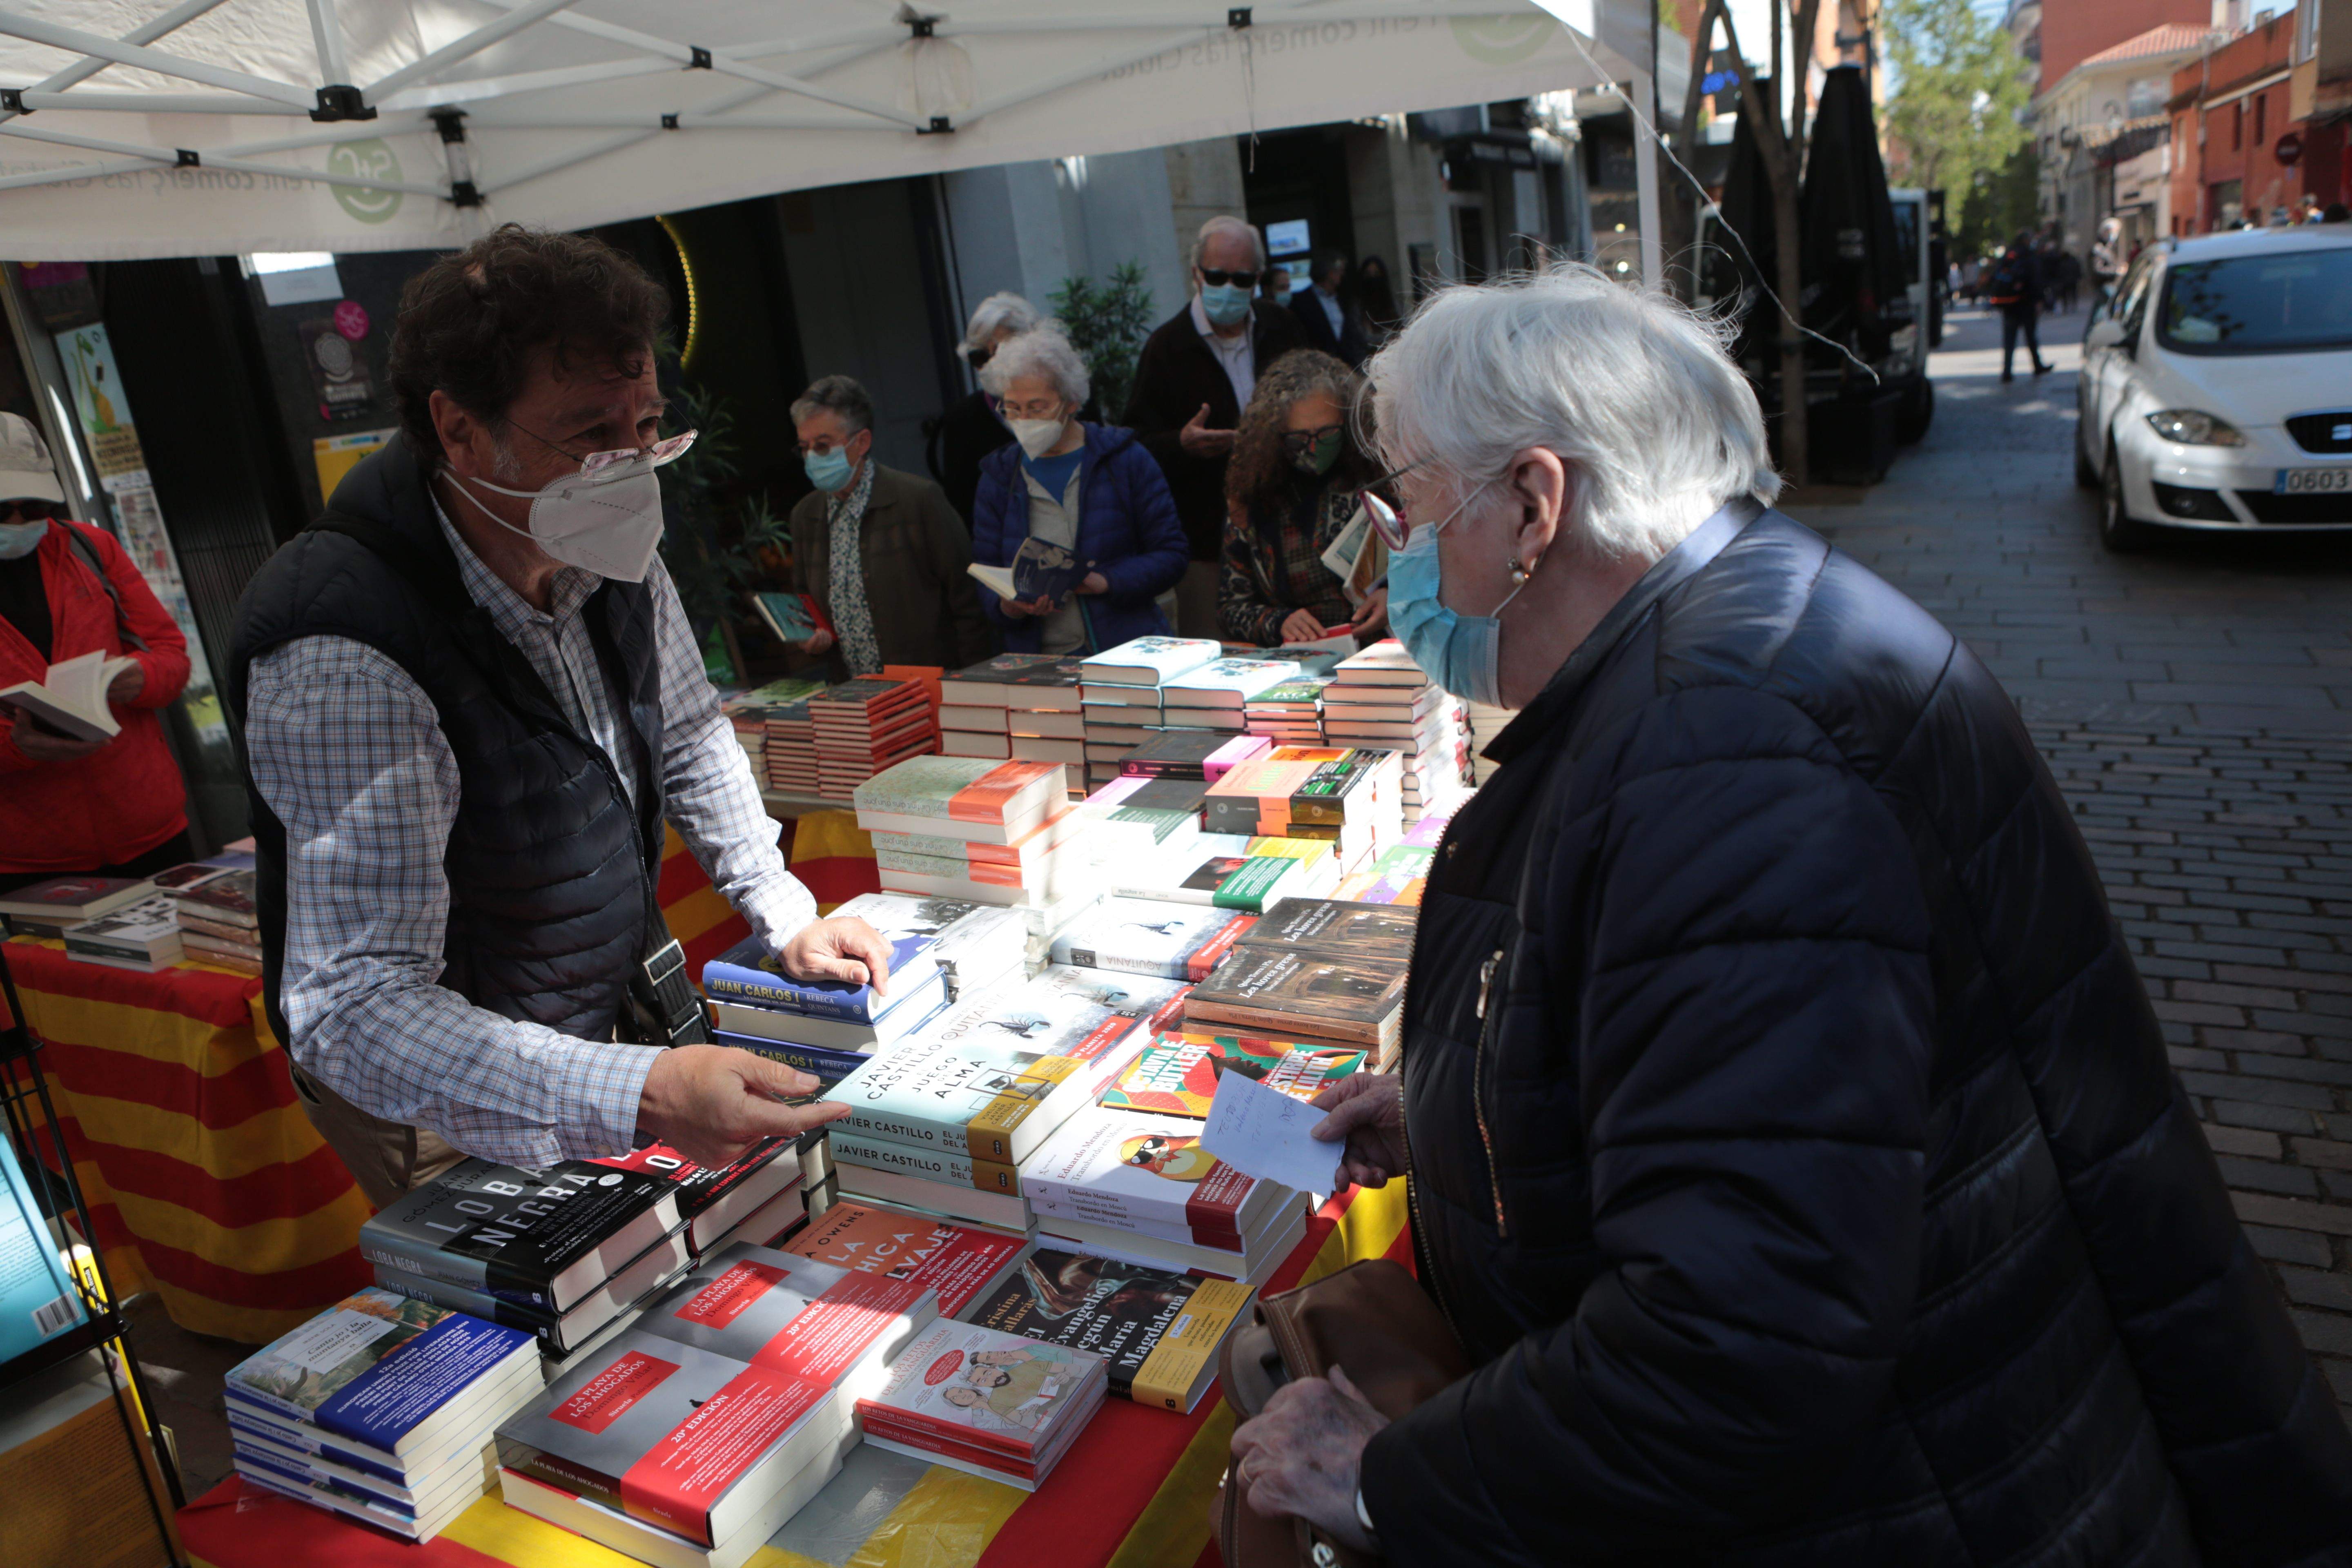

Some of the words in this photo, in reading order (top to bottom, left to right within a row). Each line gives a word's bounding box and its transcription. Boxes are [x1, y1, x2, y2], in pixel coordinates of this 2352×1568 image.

[2288, 470, 2349, 490] 0603
[1283, 930, 1299, 943] Les
[1296, 916, 1315, 933] hores
[1313, 902, 1333, 920] greus
[1106, 955, 1162, 970] AQUITANIA
[1200, 943, 1217, 957] PREMIO
[1237, 977, 1250, 989] Quim
[1249, 967, 1264, 980] Torra
[1238, 984, 1259, 999] Les
[1256, 967, 1277, 987] hores
[1275, 953, 1297, 972] greus
[711, 979, 742, 995] JUAN
[745, 984, 793, 1002] CARLOS
[795, 992, 800, 1003] I
[806, 993, 835, 1005] REBECA
[808, 1003, 841, 1014] QUINTANS
[1080, 1032, 1103, 1054] PLANETA
[1101, 1022, 1117, 1034] 2020
[759, 1049, 806, 1067] CARLOS
[820, 1060, 848, 1071] REBECA
[860, 1047, 918, 1089] JAVIER
[1147, 1044, 1211, 1094] BUTLER
[866, 1044, 943, 1100] CASTILLO
[911, 1057, 958, 1093] JUEGO
[934, 1060, 987, 1099] ALMA
[1122, 1049, 1177, 1093] OCTAVIA
[1293, 1056, 1335, 1091] LILITH
[980, 1101, 1001, 1120] VUELVE
[988, 1103, 1007, 1121] JAVIER
[991, 1101, 1016, 1125] CASTILLO
[875, 1121, 933, 1140] CASTILLO
[942, 1130, 953, 1139] EL
[942, 1138, 958, 1149] DEL
[1057, 1148, 1087, 1180] Eduardo
[1085, 1122, 1112, 1149] Mendoza
[837, 1144, 879, 1160] JAVIER
[882, 1153, 942, 1172] CASTILLO
[951, 1162, 961, 1171] EL
[1069, 1147, 1102, 1181] Transbordo
[429, 1173, 462, 1198] JUAN
[951, 1171, 967, 1180] DEL
[424, 1165, 554, 1234] LOBA
[1067, 1188, 1092, 1198] Eduardo
[1093, 1192, 1119, 1203] Mendoza
[1202, 1184, 1212, 1194] vida
[1204, 1184, 1218, 1201] secreto
[1210, 1185, 1225, 1202] Vuelve
[470, 1173, 598, 1247] NEGRA
[1069, 1196, 1100, 1207] Transbordo
[1108, 1203, 1127, 1212] Moscú
[1076, 1205, 1100, 1214] Eduardo
[1101, 1209, 1127, 1219] Mendoza
[817, 1211, 865, 1246] OWENS
[1077, 1212, 1108, 1223] Transbordo
[1116, 1220, 1135, 1228] Moscú
[372, 1249, 394, 1267] LOBA
[395, 1255, 425, 1274] NEGRA
[827, 1242, 866, 1262] LA
[853, 1233, 915, 1273] HICA
[953, 1251, 975, 1272] VENDIDOS
[927, 1258, 947, 1275] EDICIÓN
[939, 1256, 962, 1276] MILLONES
[951, 1272, 973, 1292] ESTADOS
[971, 1256, 989, 1273] UNIDOS
[955, 1261, 976, 1281] VENDIDO
[386, 1281, 407, 1296] LOBA
[691, 1298, 706, 1308] LA
[702, 1278, 730, 1298] PLAYA
[727, 1268, 743, 1279] DE
[693, 1301, 714, 1316] LOS
[712, 1267, 758, 1304] AHOGADOS
[940, 1289, 968, 1316] TRADUCIDO
[993, 1245, 1013, 1263] IDIOMAS
[705, 1287, 745, 1318] Domingo
[728, 1298, 751, 1316] Siruela
[798, 1294, 835, 1325] EDICIÓN
[308, 1333, 351, 1362] muntanya
[350, 1319, 372, 1334] balla
[1118, 1294, 1188, 1369] Magdalena
[307, 1336, 334, 1355] Canto
[393, 1346, 419, 1363] edició
[336, 1385, 373, 1414] EUROPEAN
[370, 1371, 392, 1388] UNION
[390, 1360, 410, 1374] PRIZE
[408, 1349, 423, 1362] FOR
[420, 1326, 458, 1355] LITERATURE
[454, 1320, 470, 1331] 2020
[354, 1388, 377, 1406] PREMI
[375, 1373, 398, 1391] MARIA
[422, 1337, 452, 1359] ANGLADA
[889, 1363, 903, 1378] LOS
[902, 1340, 927, 1362] RETOS
[360, 1391, 382, 1408] PREMI
[379, 1379, 399, 1394] PUNT
[406, 1358, 429, 1376] LLIBRE
[372, 1390, 394, 1407] PREMI
[416, 1360, 436, 1375] OTRA
[433, 1344, 457, 1362] MIRADA
[568, 1396, 586, 1408] LA
[582, 1373, 615, 1396] PLAYA
[612, 1362, 629, 1374] DE
[570, 1401, 592, 1418] LOS
[591, 1360, 646, 1402] AHOGADOS
[583, 1384, 629, 1420] Domingo
[625, 1365, 654, 1385] Villar
[608, 1398, 633, 1417] Siruela
[685, 1394, 730, 1430] EDICIÓN
[872, 1408, 888, 1418] RETOS
[878, 1426, 893, 1436] RETOS
[531, 1458, 539, 1466] LA
[539, 1461, 556, 1473] PLAYA
[565, 1471, 576, 1481] LOS
[576, 1475, 610, 1494] AHOGADOS
